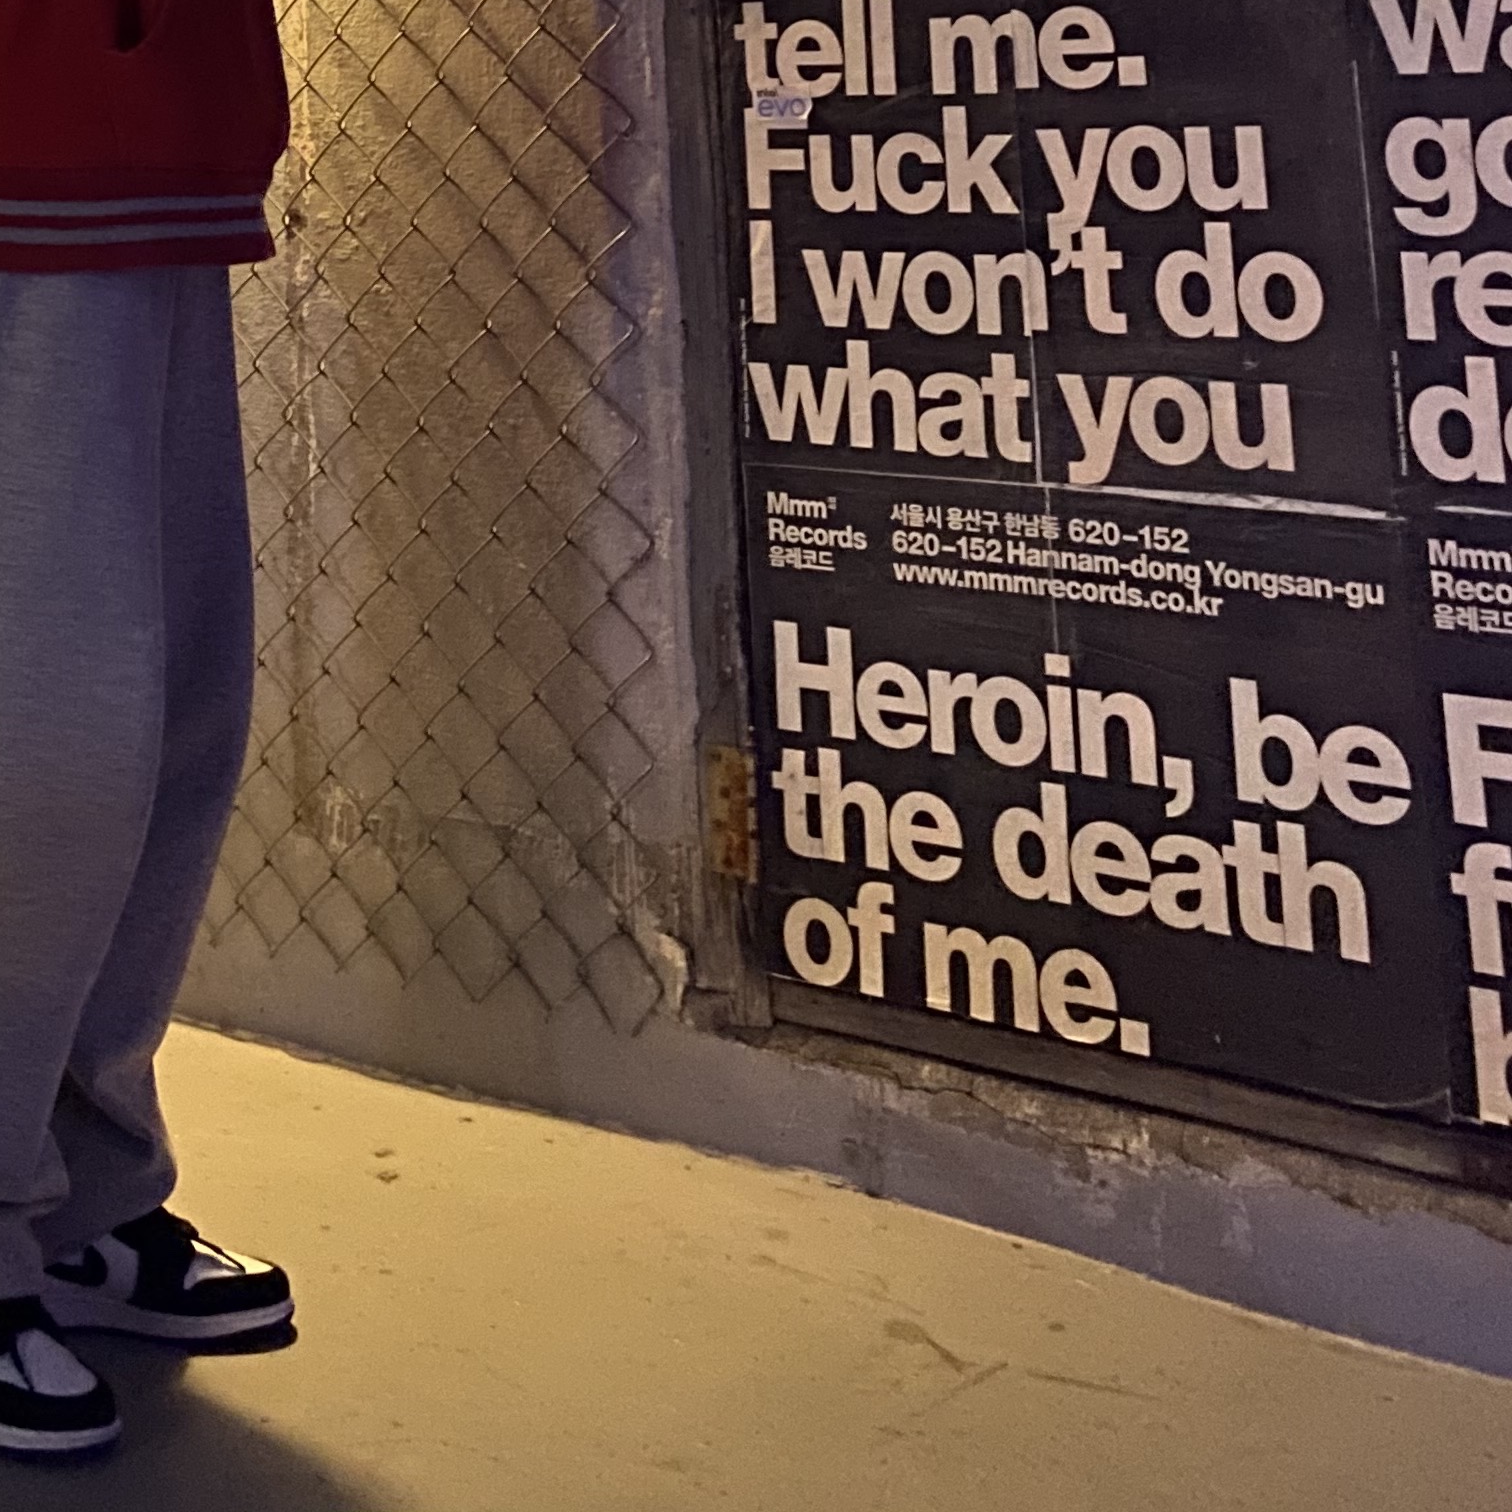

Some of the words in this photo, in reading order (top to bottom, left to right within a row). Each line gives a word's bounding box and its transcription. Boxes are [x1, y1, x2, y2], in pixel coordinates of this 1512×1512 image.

[929, 4, 1148, 95] me.
[757, 97, 807, 118] evo
[743, 105, 1020, 215] Fuck
[1035, 124, 1269, 250] you
[749, 219, 778, 324] I
[802, 225, 1128, 337] won't
[1155, 221, 1325, 343] do
[746, 339, 1033, 464] what
[1057, 372, 1295, 485] you
[768, 517, 868, 551] Records
[890, 502, 942, 530] 서울시
[945, 506, 1000, 535] 용산구
[1004, 509, 1061, 539] 한남동
[1068, 517, 1190, 554] 620-152
[892, 529, 1004, 564] 620-152
[1006, 539, 1201, 590] Hannam-dong
[1205, 559, 1385, 609] Yongsan-gu
[892, 561, 1224, 617] www.mmmrecords.co.kr
[772, 620, 1195, 818] Heroin,
[1229, 676, 1412, 826] be
[772, 748, 964, 883] the
[991, 781, 1371, 964] death
[782, 881, 895, 998] of
[923, 922, 1152, 1057] me.
